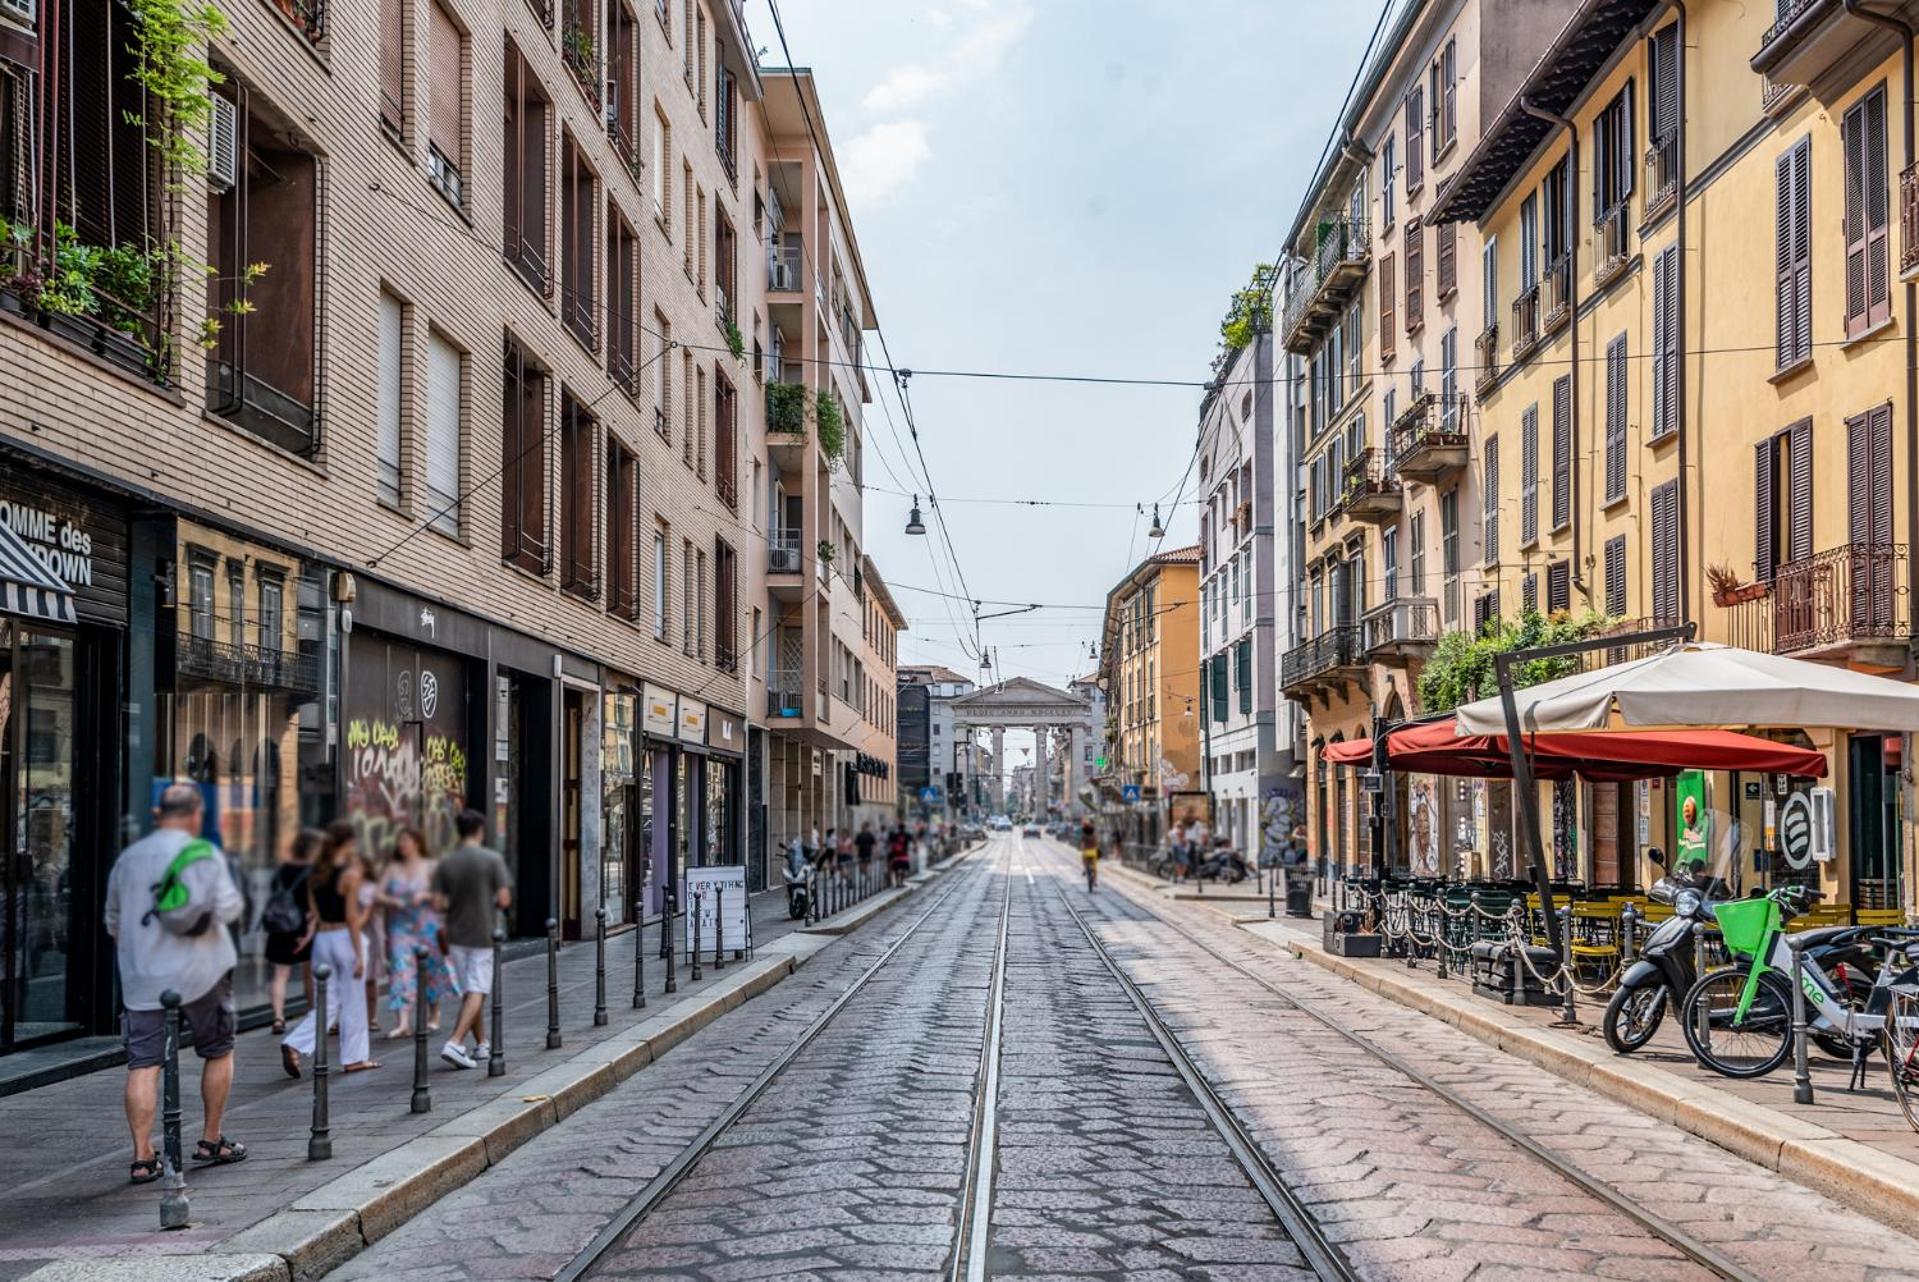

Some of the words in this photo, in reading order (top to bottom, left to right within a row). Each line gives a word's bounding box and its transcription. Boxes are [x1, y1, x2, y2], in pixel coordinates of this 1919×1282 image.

[61, 521, 91, 555] des
[22, 541, 91, 586] DOWN
[688, 891, 707, 900] OD
